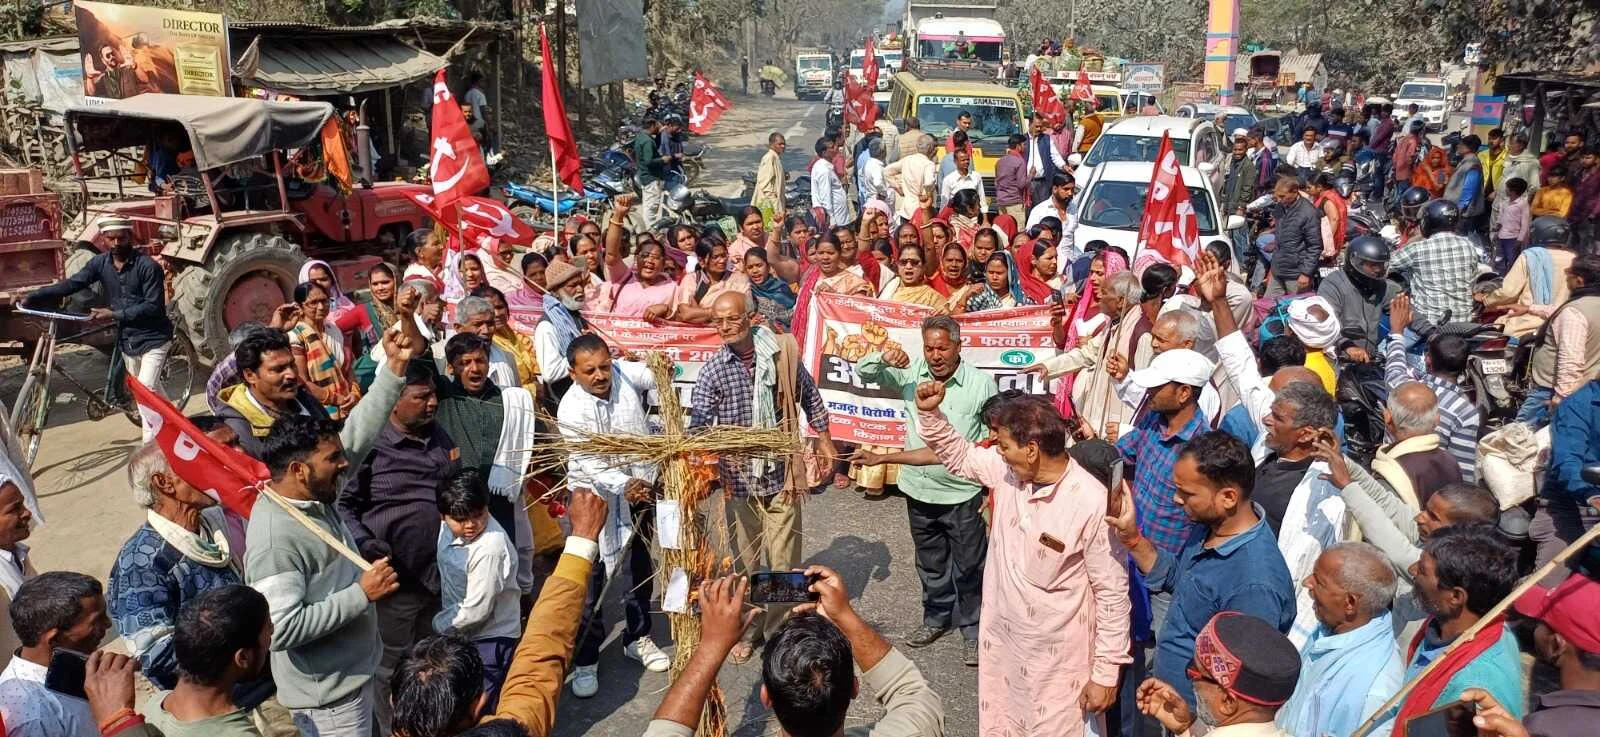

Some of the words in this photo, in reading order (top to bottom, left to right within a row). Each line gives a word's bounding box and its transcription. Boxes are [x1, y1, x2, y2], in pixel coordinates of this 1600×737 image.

[162, 18, 220, 33] DIRECTOR
[960, 335, 972, 347] 2
[979, 334, 1034, 347] फरवरी
[689, 350, 713, 361] 20
[1007, 352, 1027, 364] को
[828, 401, 858, 415] मजदूर
[863, 405, 896, 418] विरोधी
[853, 429, 894, 441] किसान
